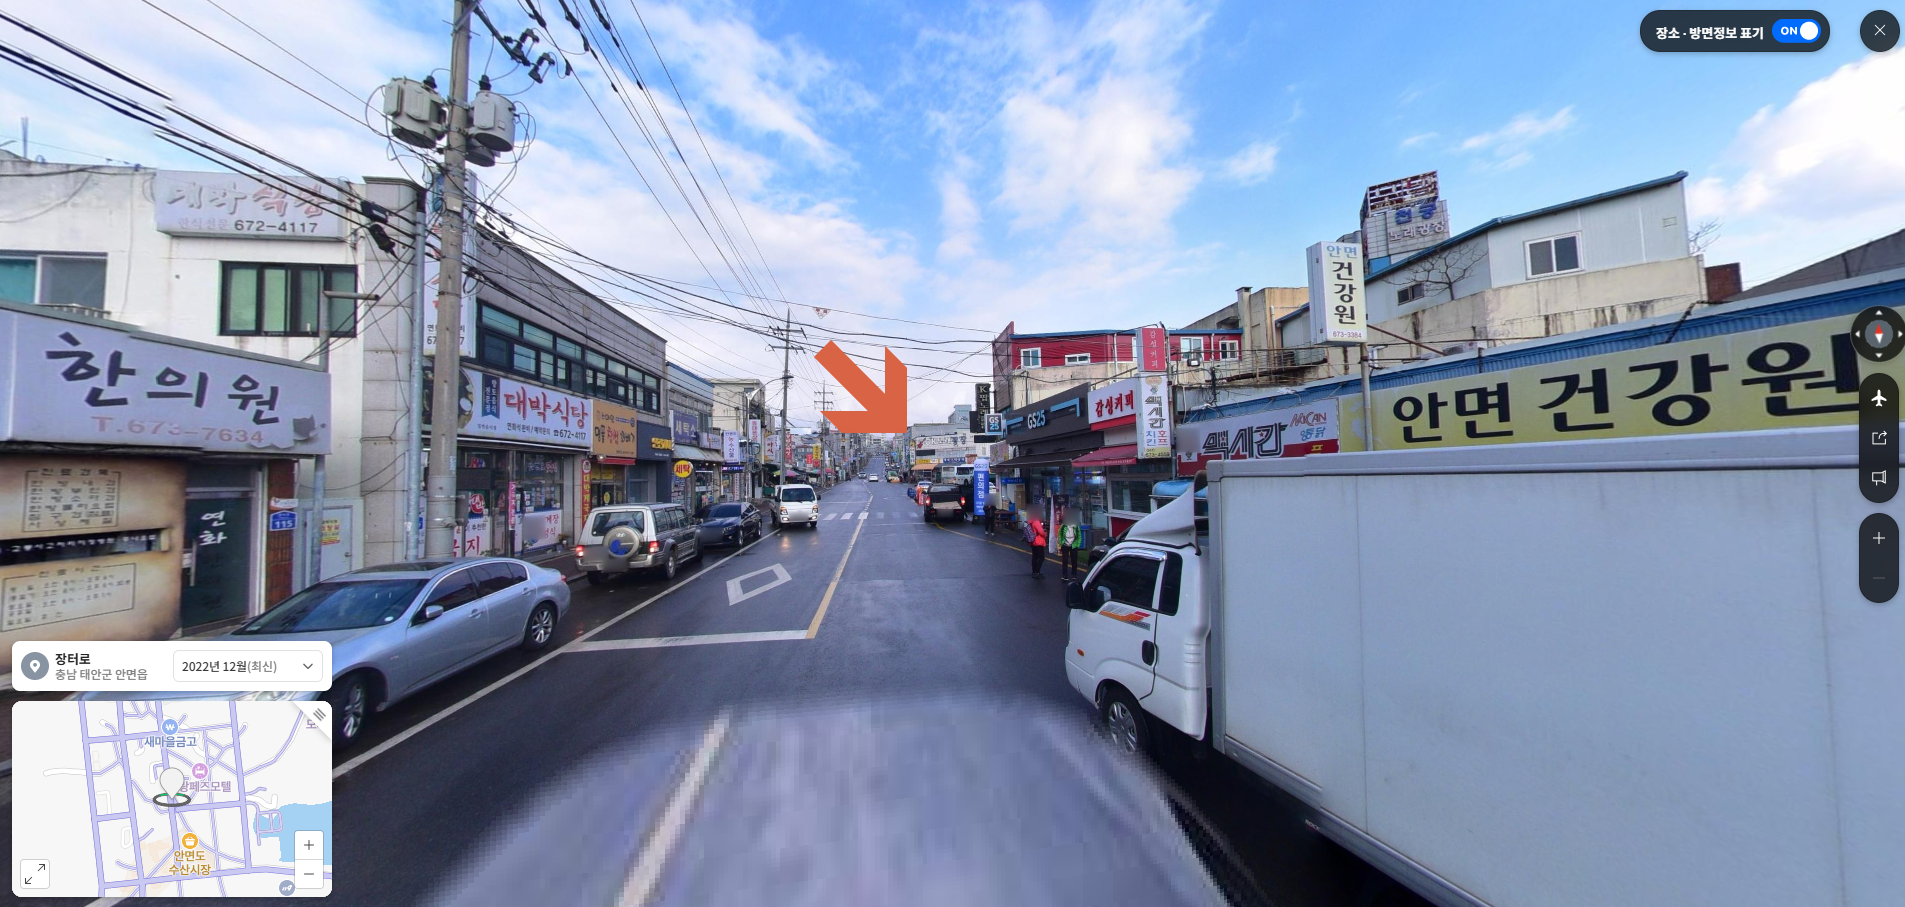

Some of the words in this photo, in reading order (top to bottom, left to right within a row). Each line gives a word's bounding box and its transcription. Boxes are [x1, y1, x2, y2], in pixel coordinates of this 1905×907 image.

[234, 219, 319, 233] 672-4117
[1389, 220, 1446, 241] 노래광장
[1326, 245, 1358, 259] 안면
[1332, 261, 1357, 325] 건강원
[1332, 330, 1362, 339] 673-3384
[1149, 330, 1158, 369] 감성커피
[46, 331, 280, 425] 한의원
[1393, 382, 1514, 443] 안면
[1538, 332, 1860, 433] 건강원
[503, 386, 589, 429] 대박식당
[1095, 390, 1134, 418] 감성커피
[91, 416, 265, 444] T.673-7634
[675, 420, 696, 438] 세탁소
[989, 416, 1000, 424] GS
[1027, 409, 1046, 430] GS25
[560, 430, 587, 440] 672-4117
[1146, 430, 1156, 447] 치킨
[1157, 430, 1167, 446] 호프
[675, 464, 691, 475] 세탁
[977, 473, 985, 499] 편의점
[200, 510, 227, 546] 연화
[274, 519, 294, 529] 115
